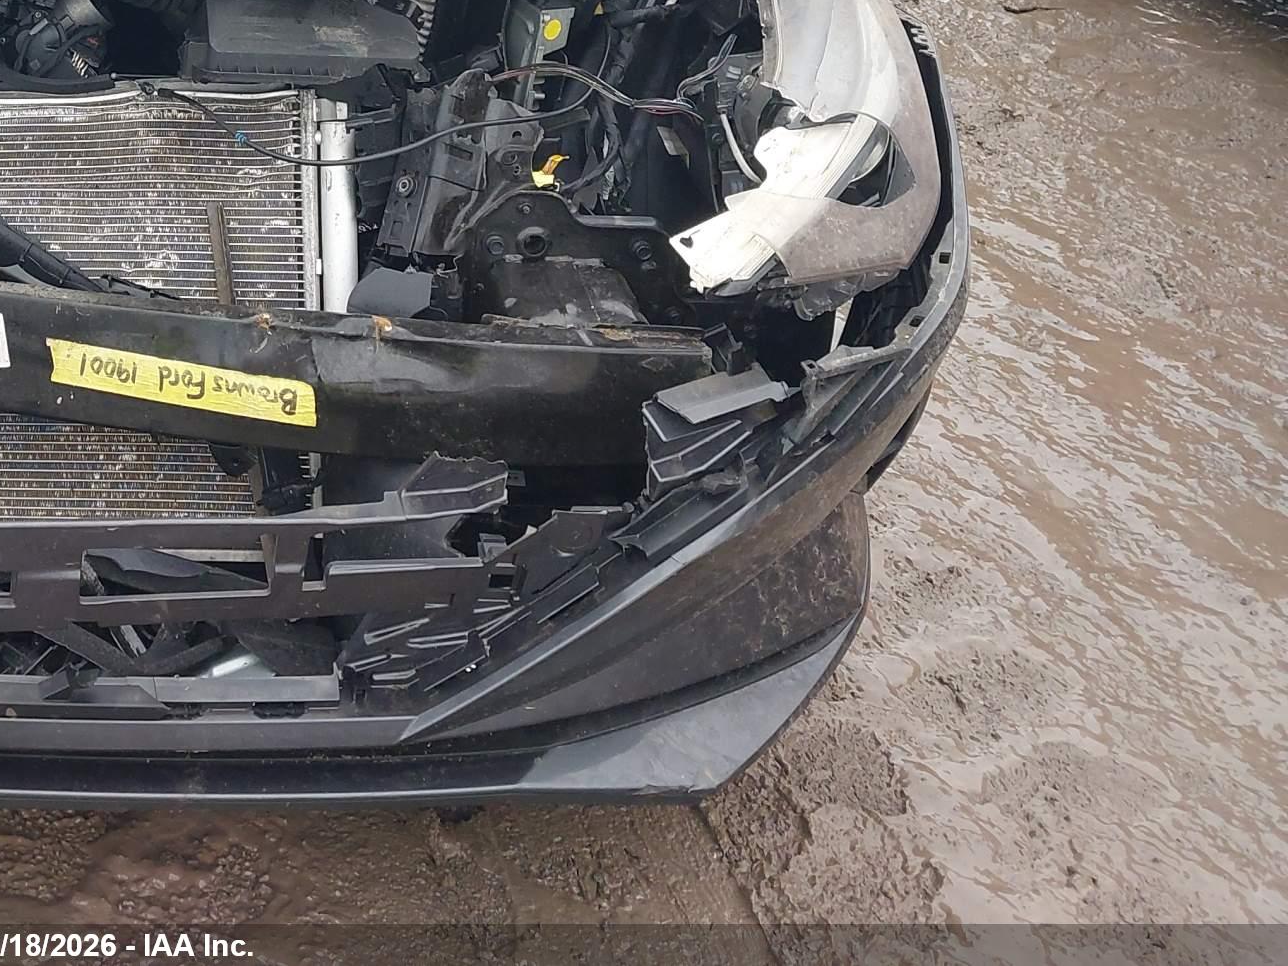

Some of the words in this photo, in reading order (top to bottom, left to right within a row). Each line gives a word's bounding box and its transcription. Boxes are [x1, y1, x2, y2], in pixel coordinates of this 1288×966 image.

[79, 353, 138, 384] 19001
[158, 365, 206, 400] Ford
[213, 375, 298, 415] Browns
